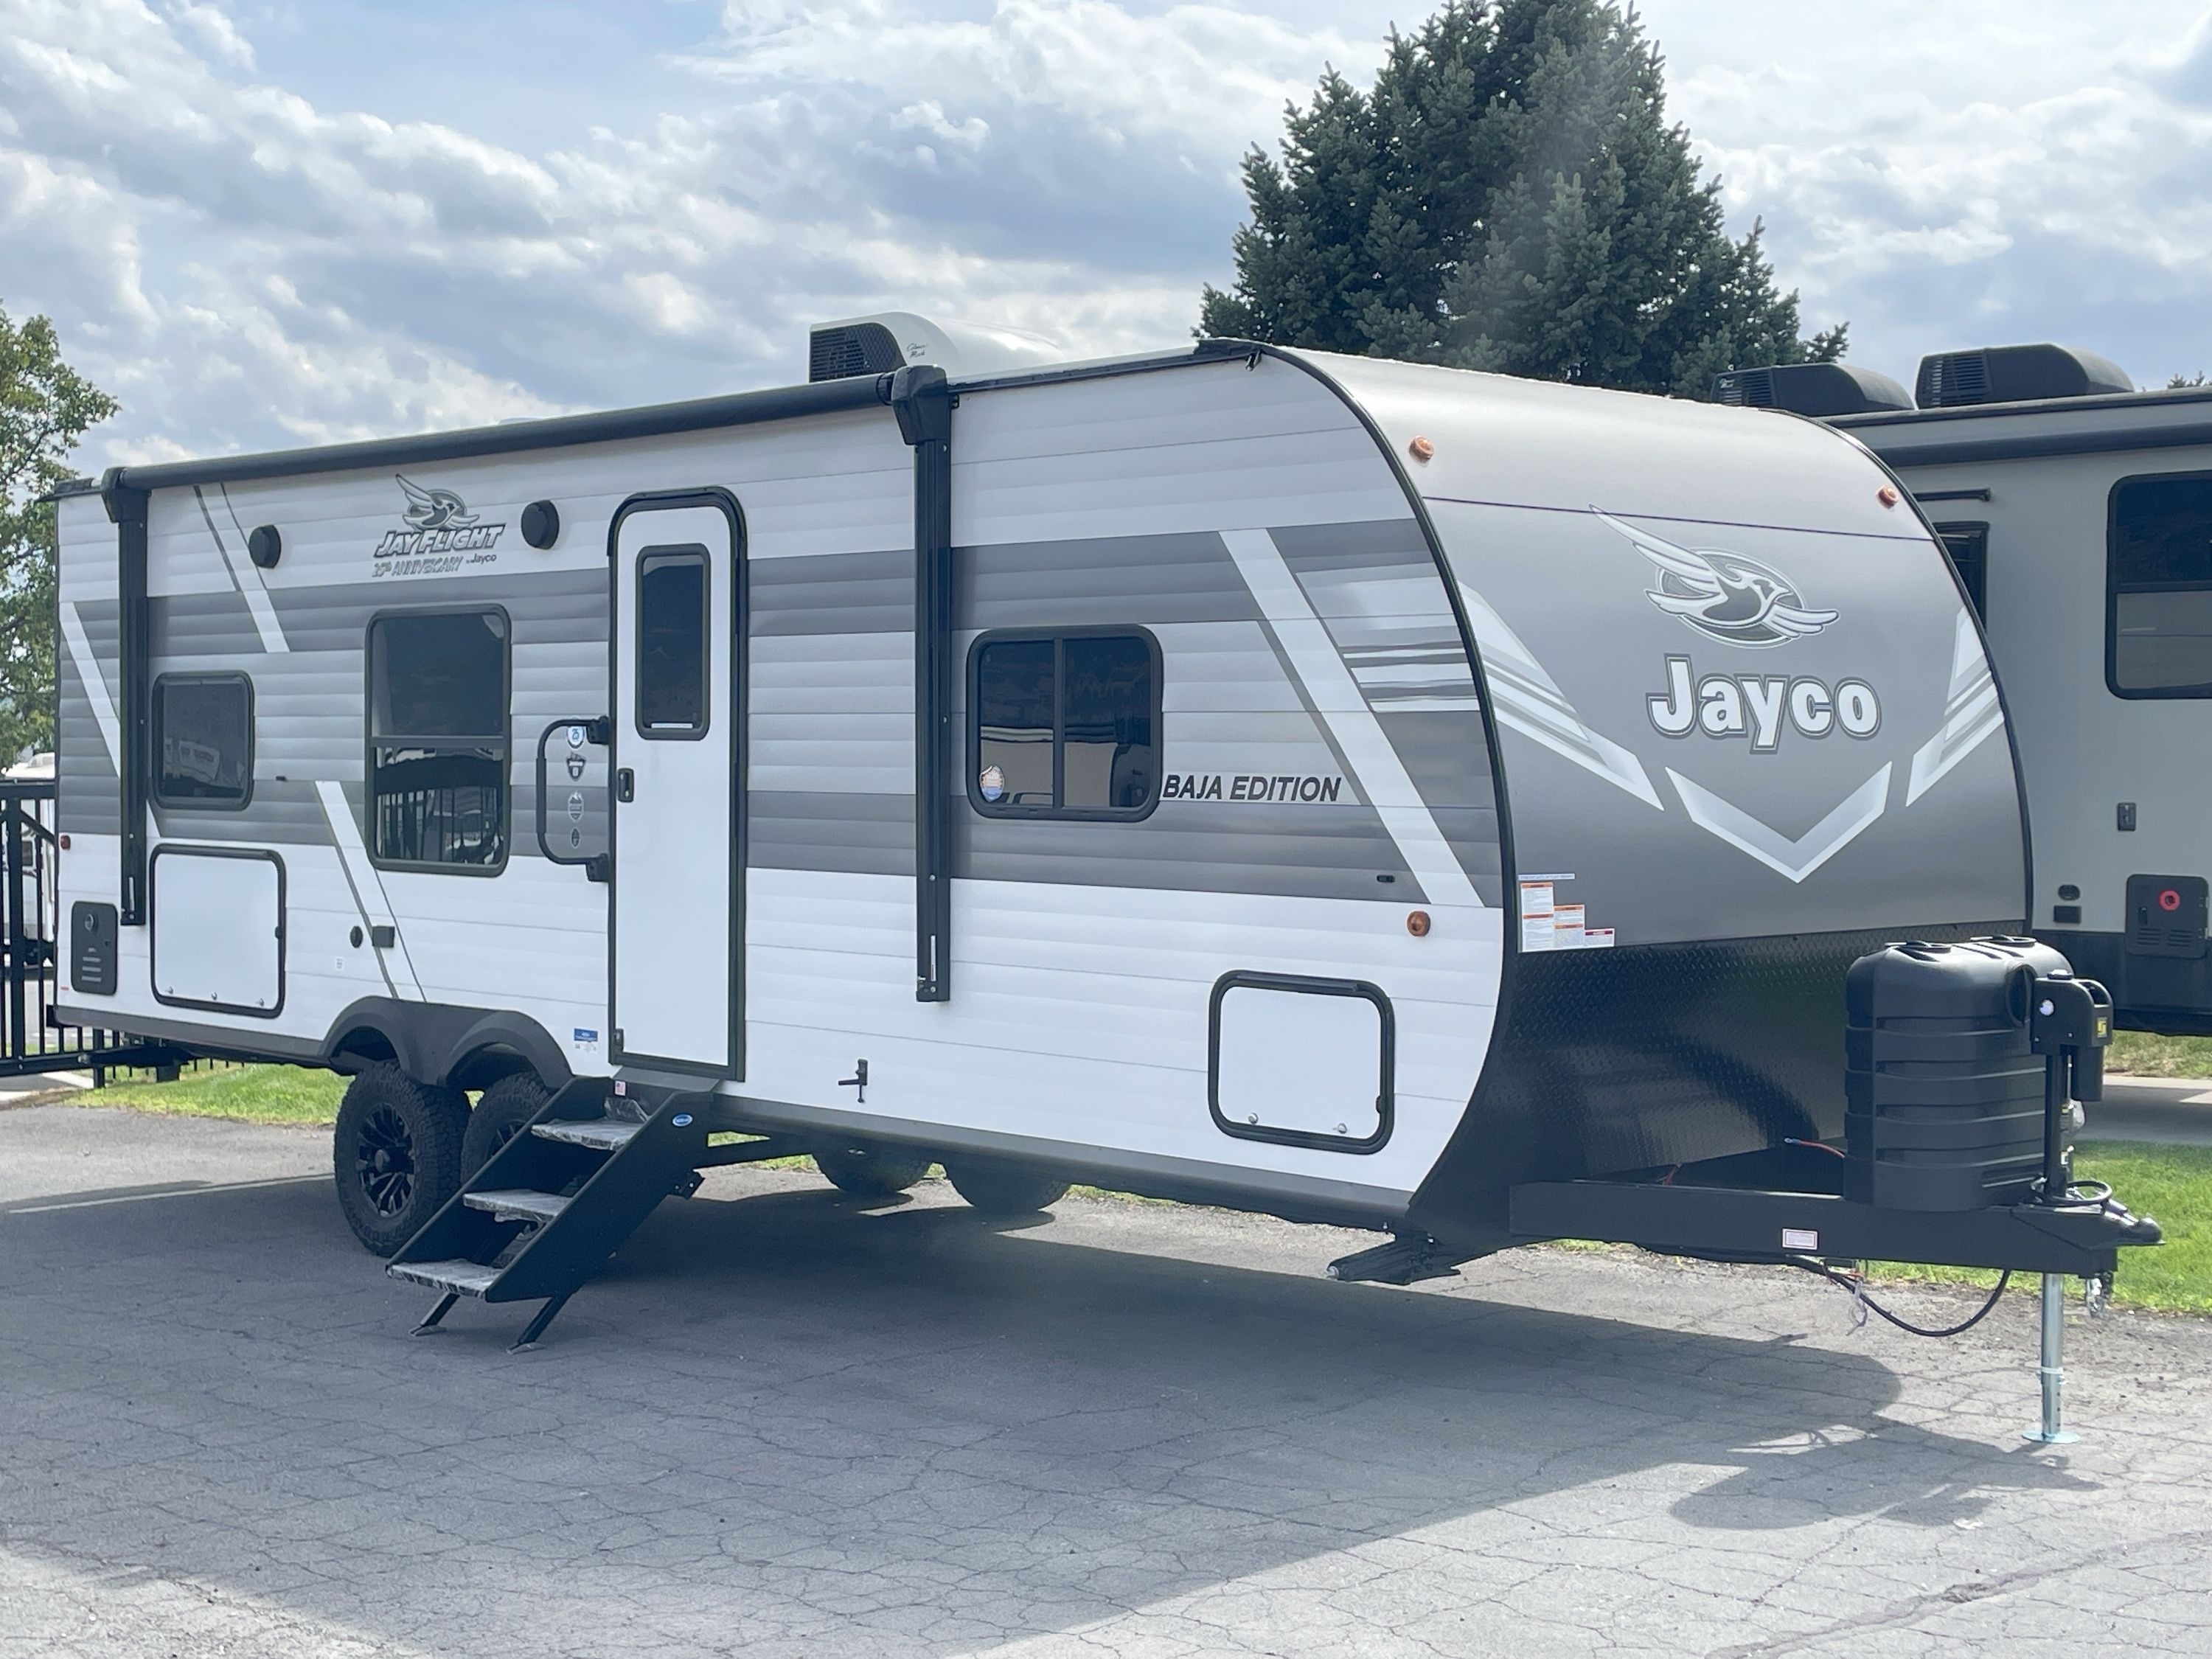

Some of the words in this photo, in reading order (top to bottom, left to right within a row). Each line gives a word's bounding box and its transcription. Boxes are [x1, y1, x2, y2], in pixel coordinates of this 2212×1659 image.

[470, 552, 497, 565] Jayco
[1646, 653, 1882, 754] Jayco
[1163, 774, 1222, 799] BAJA
[1229, 776, 1342, 801] EDITION
